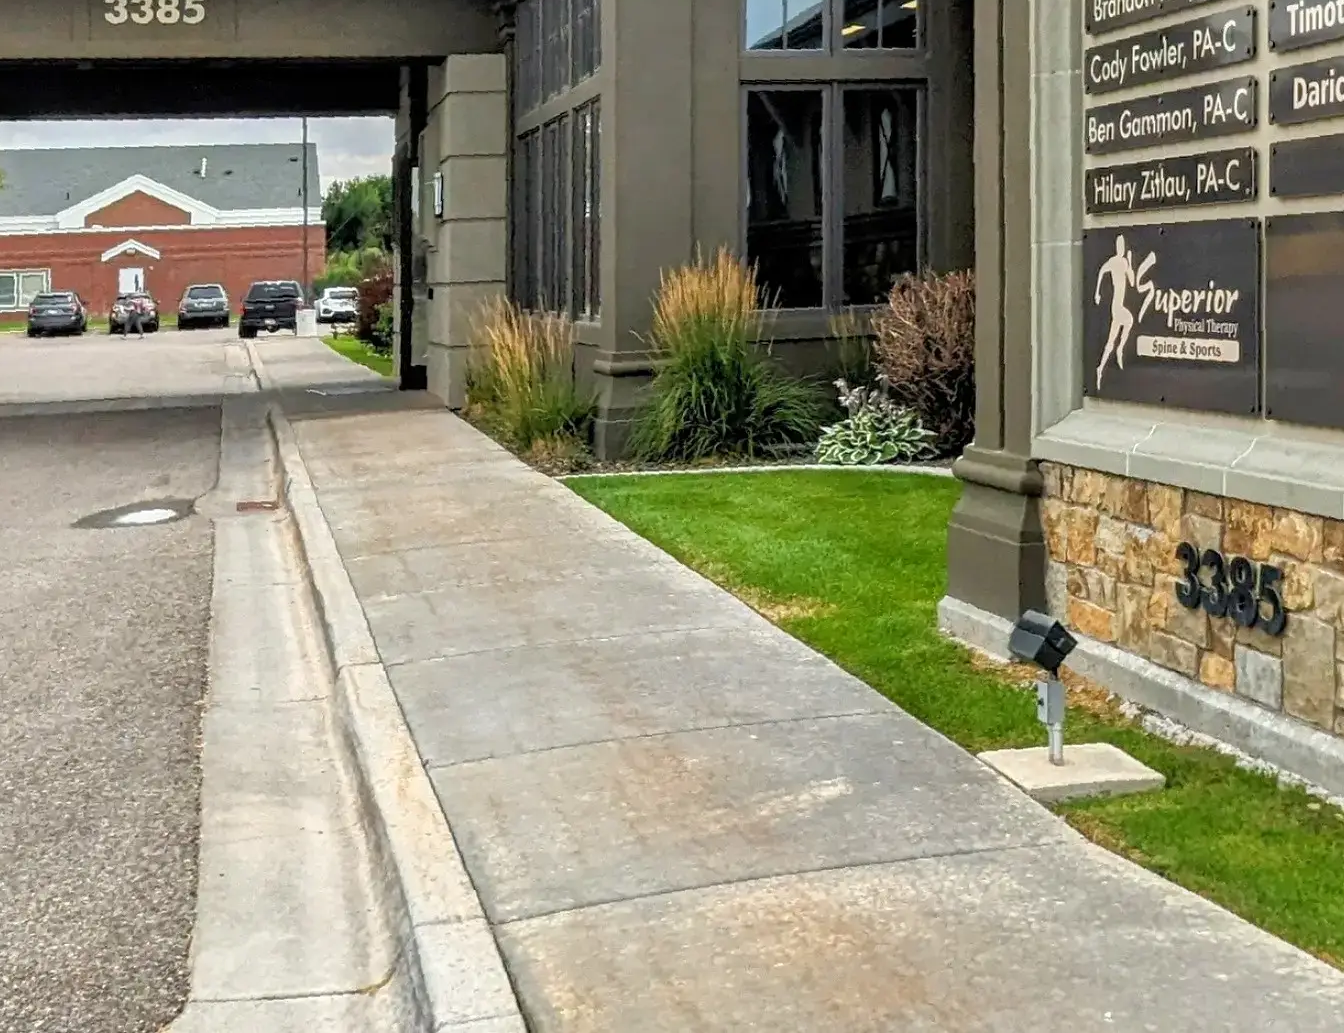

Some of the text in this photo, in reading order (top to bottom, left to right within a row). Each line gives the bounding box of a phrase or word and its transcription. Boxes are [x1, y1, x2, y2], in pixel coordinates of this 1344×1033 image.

[1090, 19, 1236, 85] Cody Fowler, PA-C
[1088, 88, 1248, 143] Ben Gammon, PA-C
[1094, 159, 1240, 209] Hilary Zitlau, PA-C
[1136, 250, 1239, 327] Superior
[1152, 339, 1222, 357] Spine & Sports
[1174, 318, 1239, 338] Physical Therapy
[1175, 541, 1288, 636] 3385
